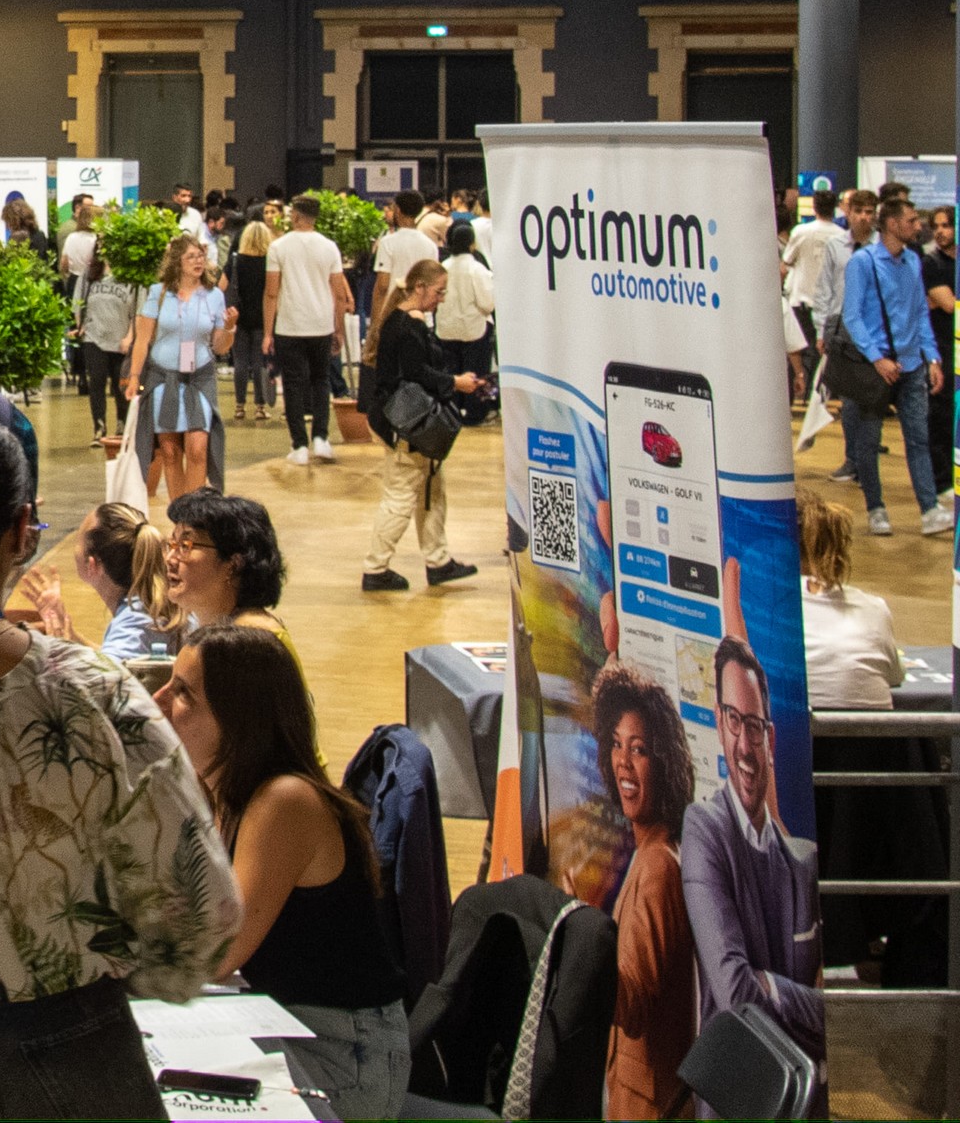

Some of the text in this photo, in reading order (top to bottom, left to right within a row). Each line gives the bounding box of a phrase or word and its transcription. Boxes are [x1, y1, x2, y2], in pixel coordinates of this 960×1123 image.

[591, 269, 707, 308] automotive
[627, 477, 669, 495] VOLKSWAGEN
[674, 487, 693, 499] GOLF
